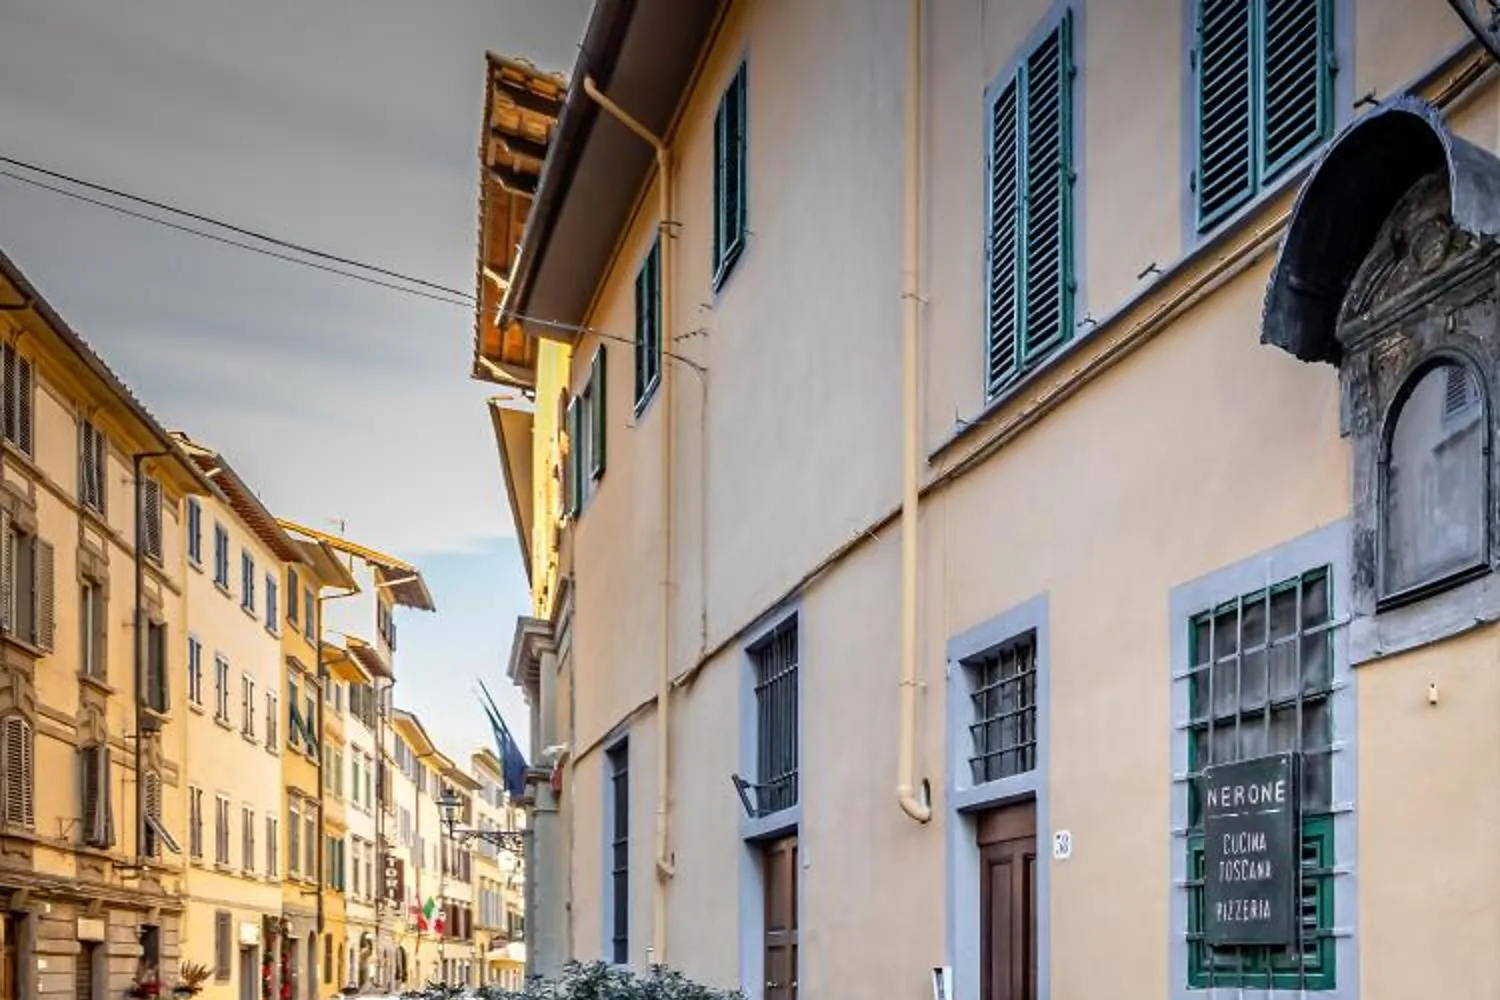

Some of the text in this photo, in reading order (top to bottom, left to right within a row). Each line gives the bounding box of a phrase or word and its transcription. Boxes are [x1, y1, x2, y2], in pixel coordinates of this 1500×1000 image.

[1207, 780, 1286, 808] NERONE
[1222, 832, 1268, 855] CUCINA
[1218, 860, 1272, 884] TOSCANA
[1216, 900, 1272, 922] PIZZERIA
